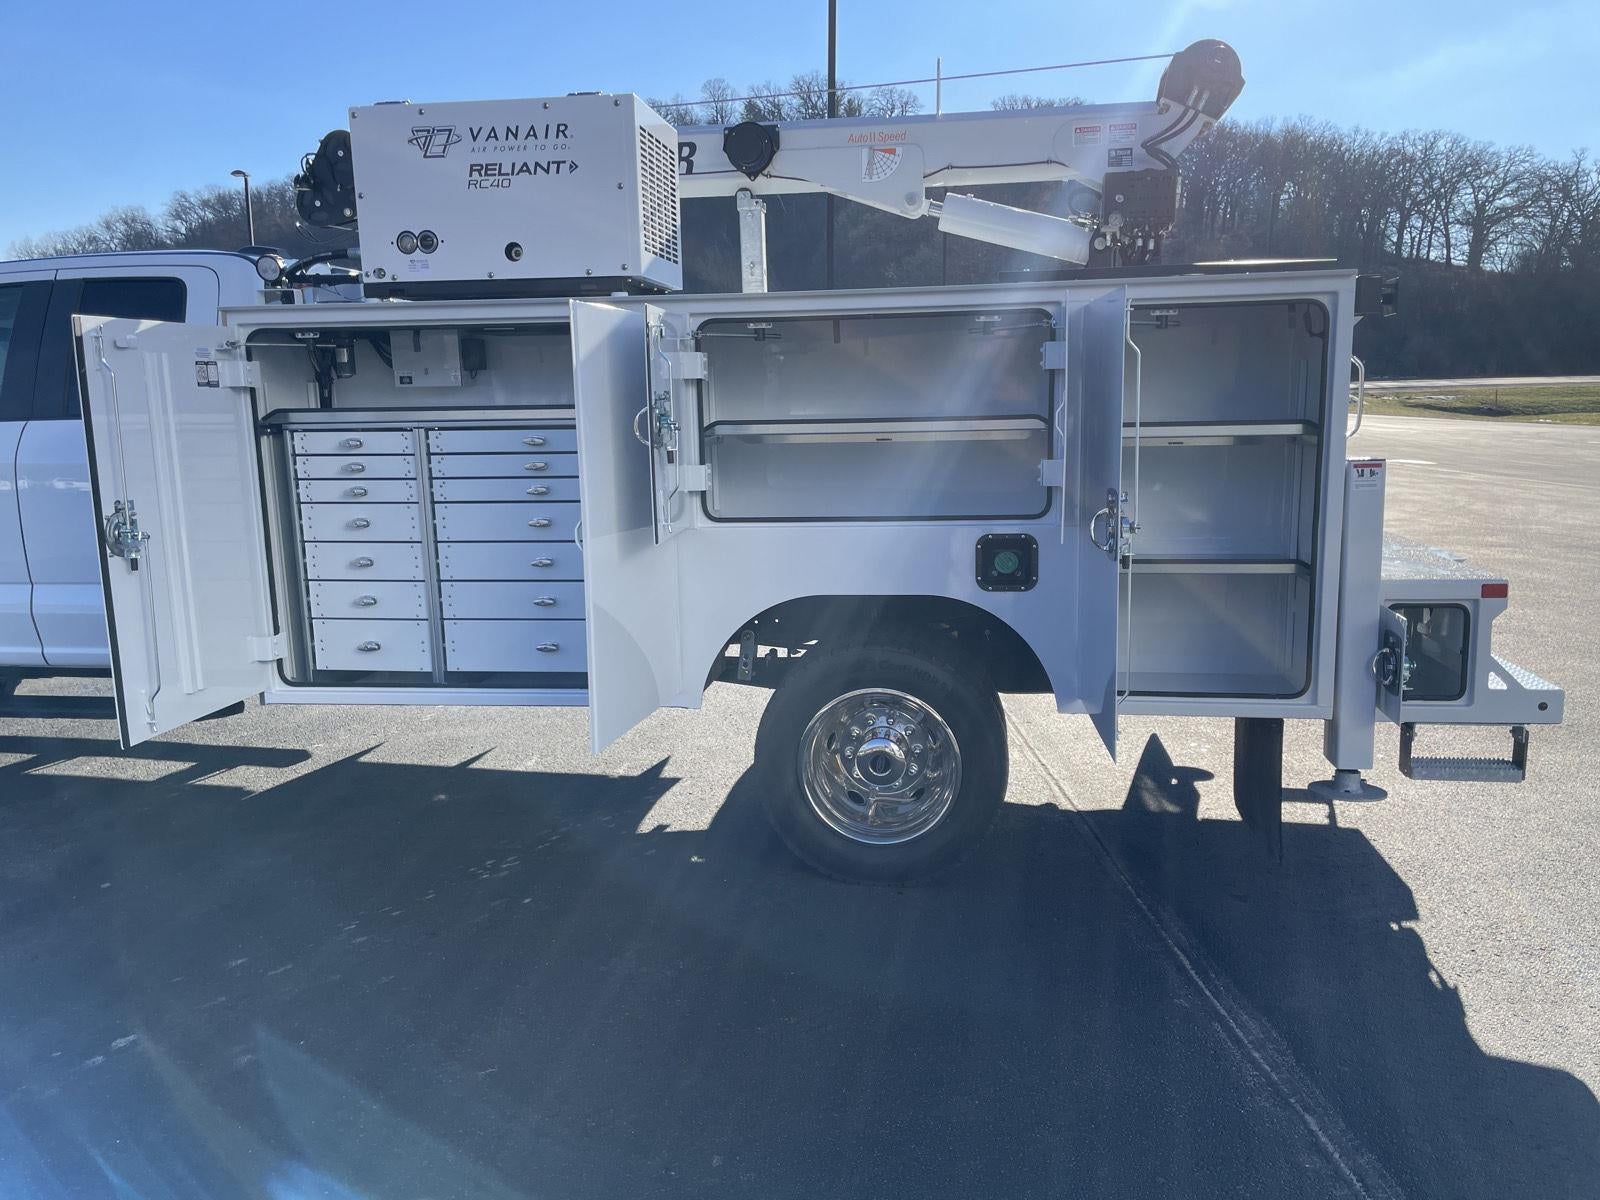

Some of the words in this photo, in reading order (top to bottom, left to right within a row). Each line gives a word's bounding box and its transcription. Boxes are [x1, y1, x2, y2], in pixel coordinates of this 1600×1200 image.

[469, 123, 569, 143] VANAIR
[878, 129, 907, 143] Speed
[493, 145, 528, 153] POWER
[534, 144, 547, 152] TO
[468, 160, 567, 178] RELIANT
[467, 178, 512, 190] RC40
